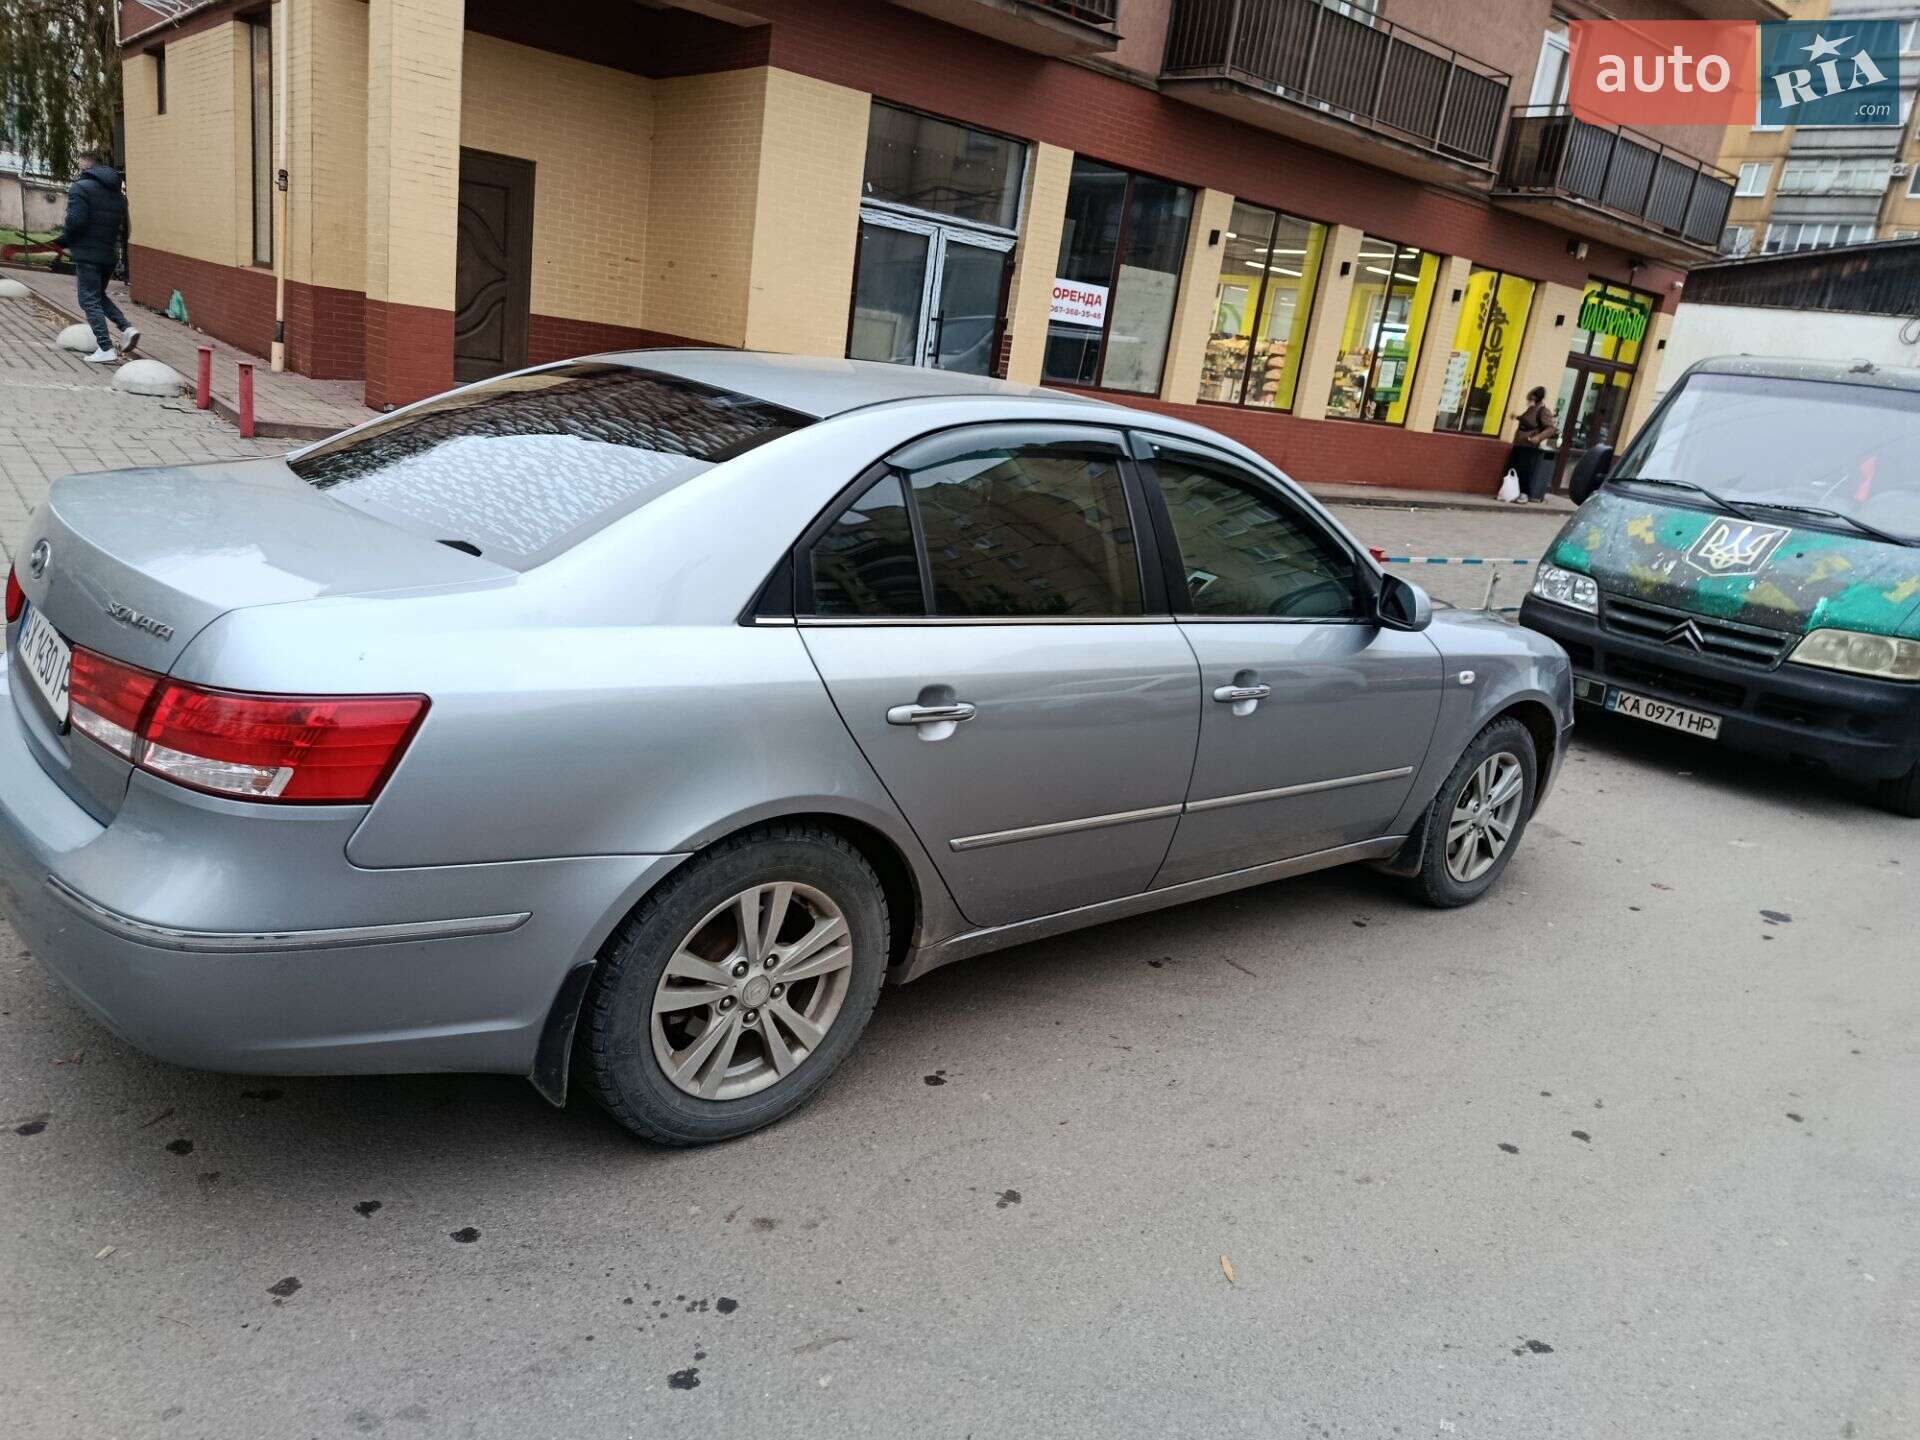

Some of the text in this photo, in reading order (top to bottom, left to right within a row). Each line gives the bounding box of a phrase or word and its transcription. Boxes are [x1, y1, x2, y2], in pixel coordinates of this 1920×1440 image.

[1052, 286, 1102, 308] ОРЕНДА
[106, 602, 174, 642] SONATA
[33, 627, 59, 686] 1430
[1617, 693, 1640, 715] KA
[1645, 702, 1685, 727] 0971
[1687, 713, 1714, 733] HP
